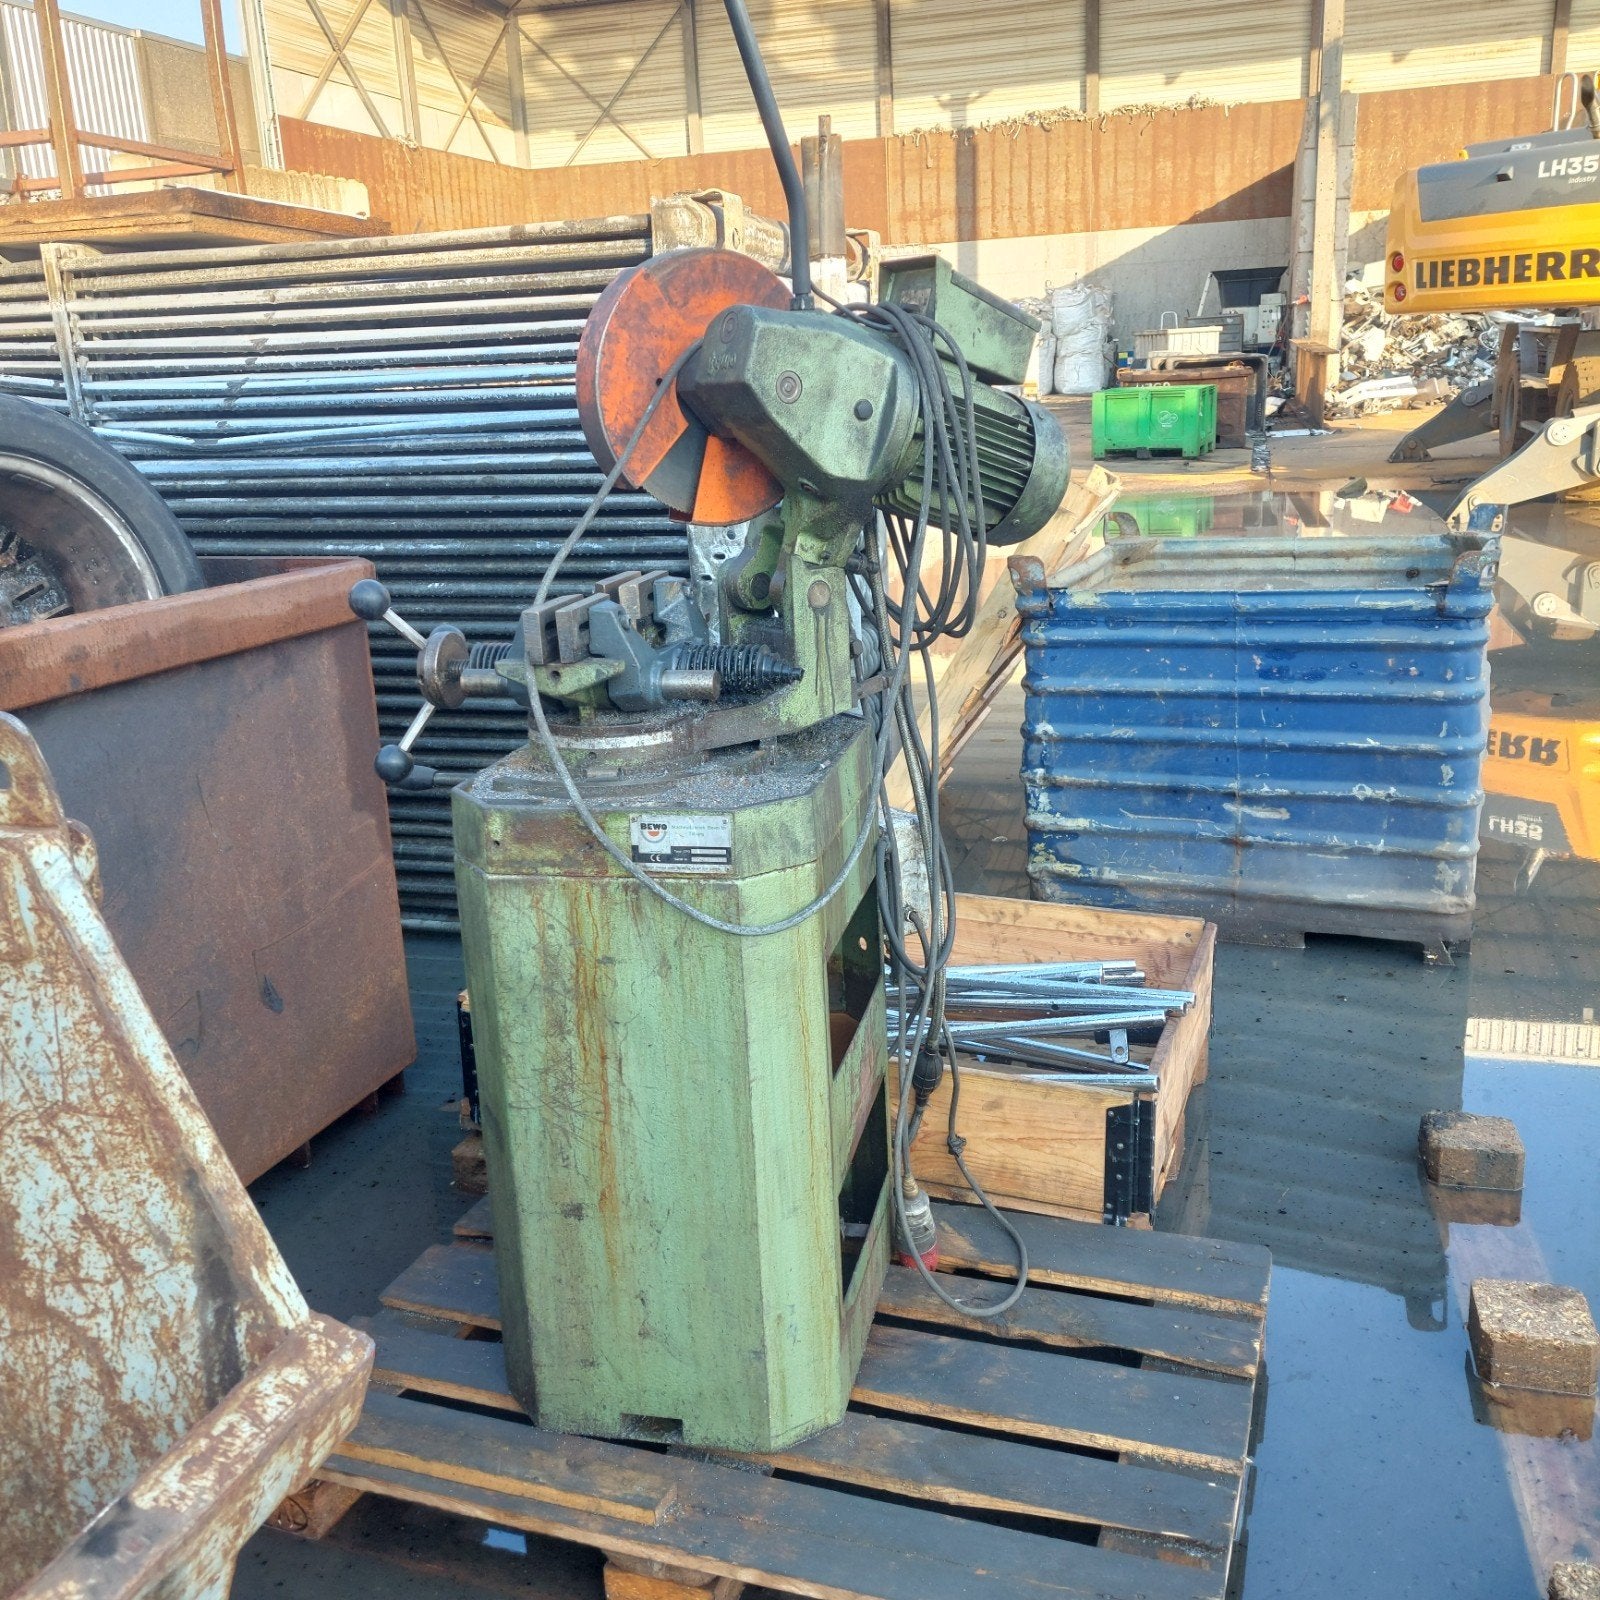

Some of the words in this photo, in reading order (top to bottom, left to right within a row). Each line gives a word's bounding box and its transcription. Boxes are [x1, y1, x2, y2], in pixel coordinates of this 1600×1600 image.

[1538, 155, 1600, 178] LH35
[1416, 249, 1600, 289] LIEBHERR
[640, 823, 668, 831] BEWO
